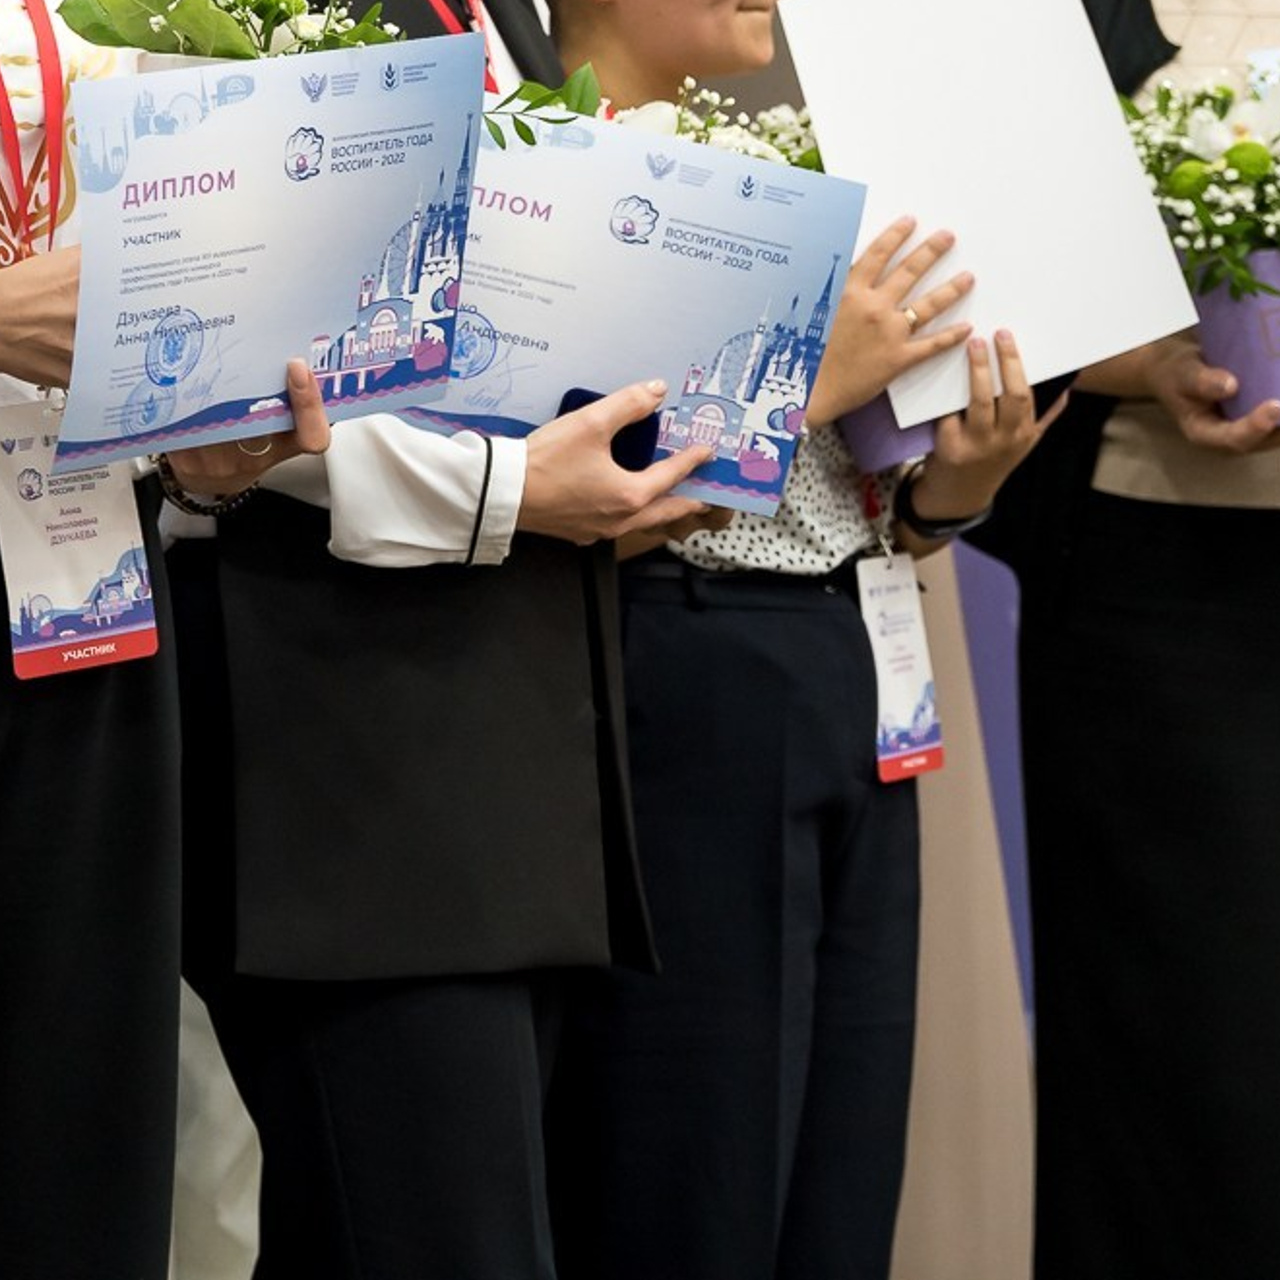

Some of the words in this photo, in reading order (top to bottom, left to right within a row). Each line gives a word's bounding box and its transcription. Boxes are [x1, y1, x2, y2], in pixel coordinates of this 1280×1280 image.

[331, 138, 405, 159] ВОСПИТАТЕЛЬ
[406, 133, 433, 147] ГОДА
[331, 158, 373, 173] РОССИИ
[381, 152, 406, 167] 2022
[123, 169, 236, 209] ДИПЛОМ
[472, 186, 553, 222] ПЛОМ
[123, 229, 181, 248] УЧАСТНИК
[665, 226, 753, 257] ВОСПИТАТЕЛЬ
[755, 249, 789, 265] ГОДА
[662, 241, 712, 261] РОССИИ
[722, 255, 754, 271] 2022
[114, 331, 150, 348] Анна
[154, 315, 236, 339] Николаевна
[116, 305, 181, 329] Дзукаева
[460, 320, 550, 351] Андреевна
[62, 642, 116, 662] УЧАСТНИК
